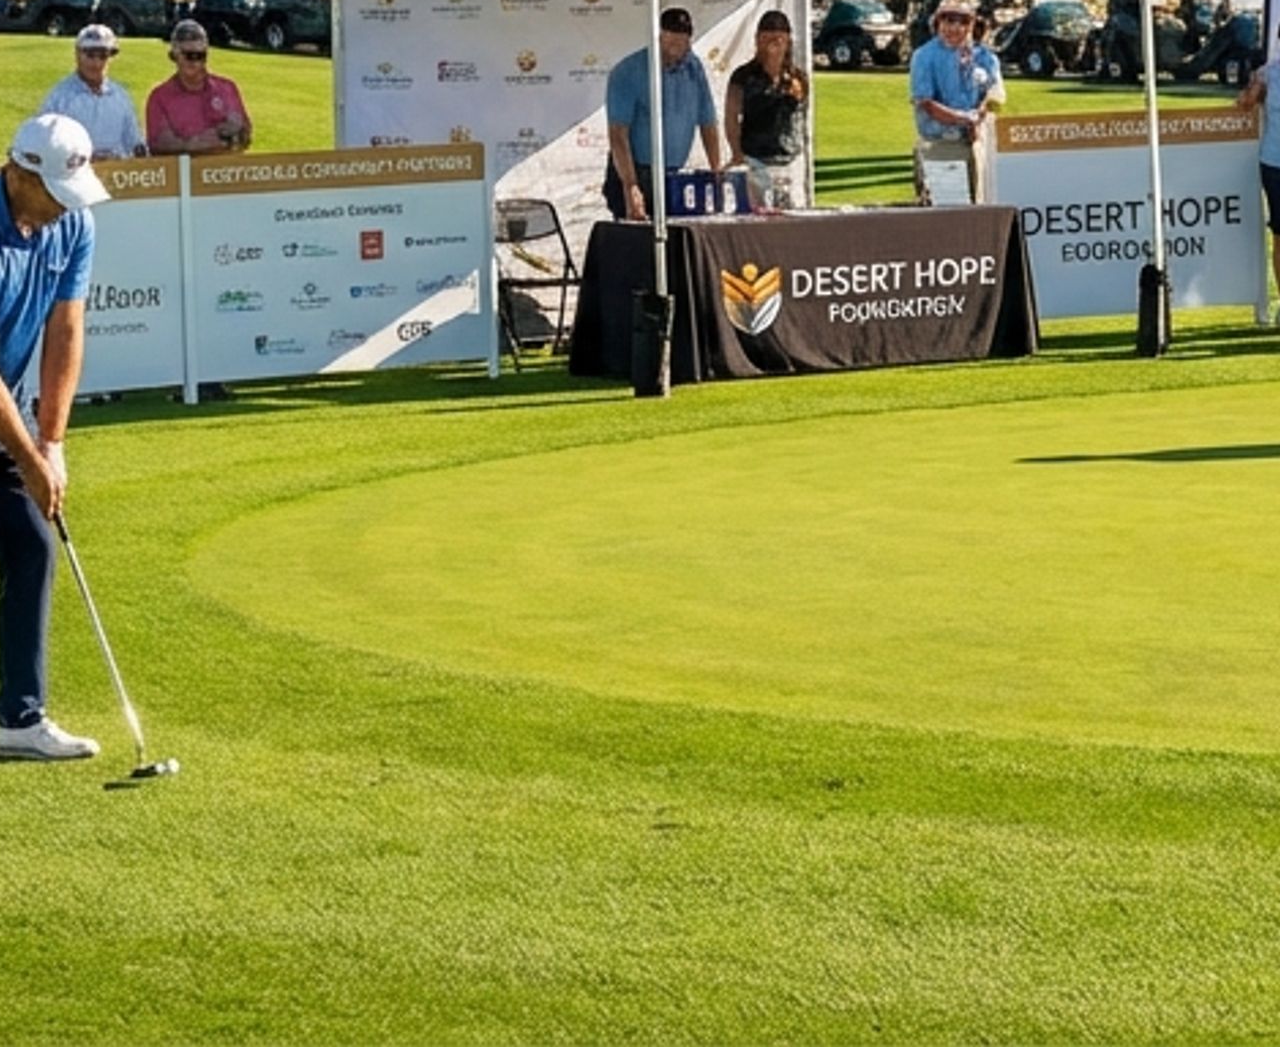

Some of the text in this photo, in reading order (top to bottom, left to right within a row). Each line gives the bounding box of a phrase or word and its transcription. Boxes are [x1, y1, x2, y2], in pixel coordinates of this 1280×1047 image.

[1020, 200, 1145, 237] DESERT
[791, 255, 997, 299] DESERT HOPE
